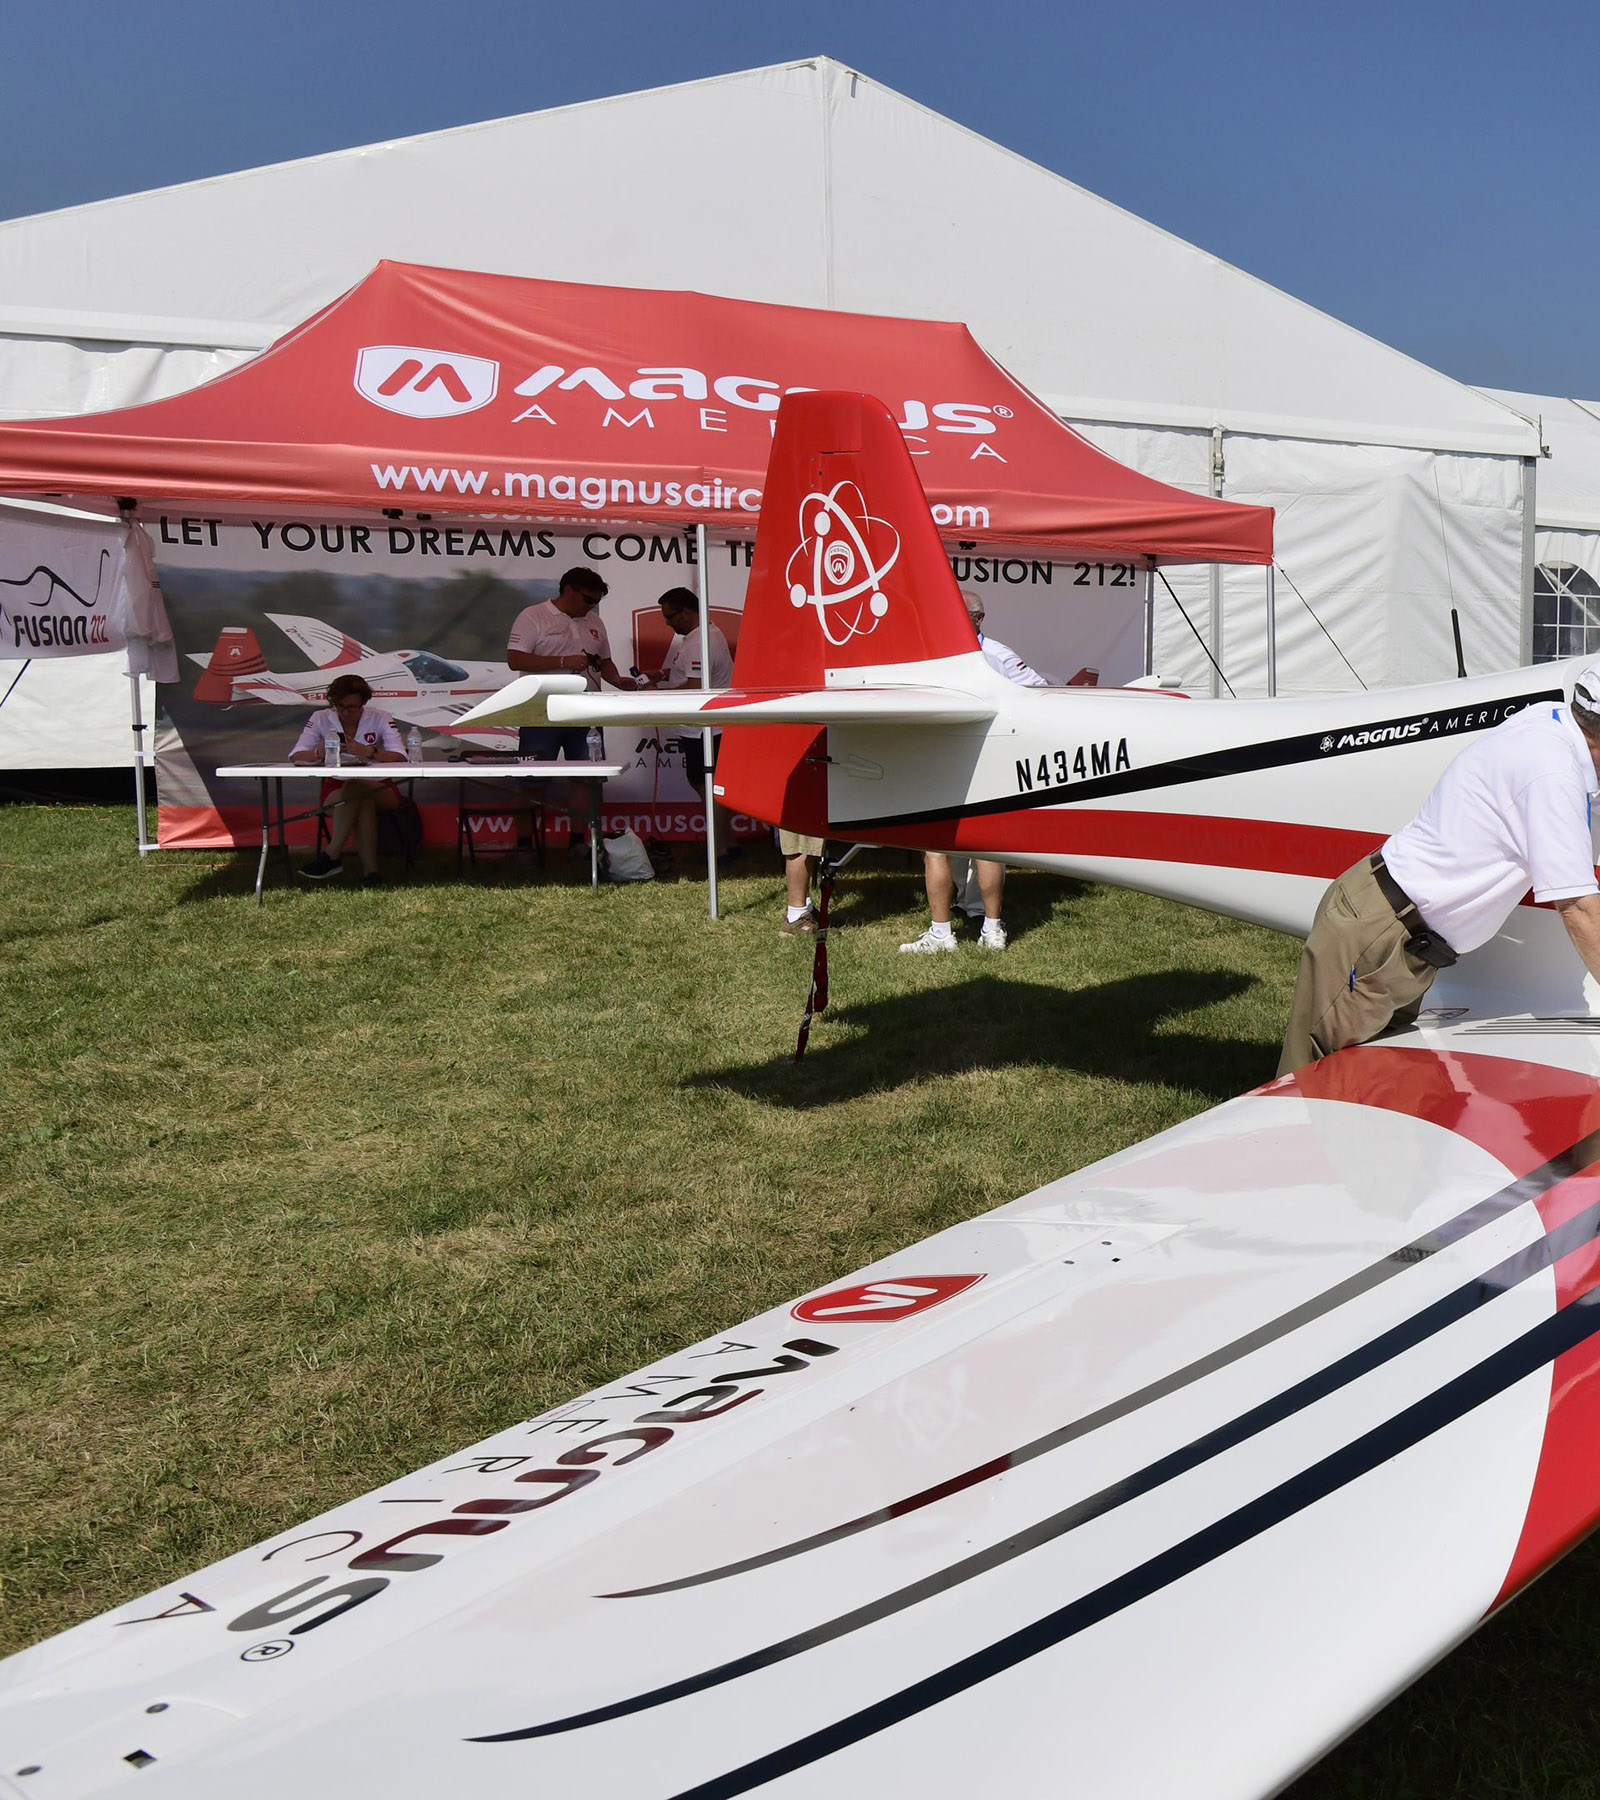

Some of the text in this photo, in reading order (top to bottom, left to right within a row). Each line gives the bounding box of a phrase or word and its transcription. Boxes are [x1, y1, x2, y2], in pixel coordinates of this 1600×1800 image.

[511, 403, 1008, 463] AMEA
[160, 515, 223, 547] LET
[251, 520, 373, 554] YOUR
[387, 526, 556, 559] DREAMS
[582, 532, 698, 565] COME
[953, 556, 1053, 585] USION
[1073, 561, 1136, 588] 212!
[13, 614, 110, 648] FUSION 212
[1429, 702, 1532, 734] AMERIC
[1016, 737, 1131, 792] N434MA
